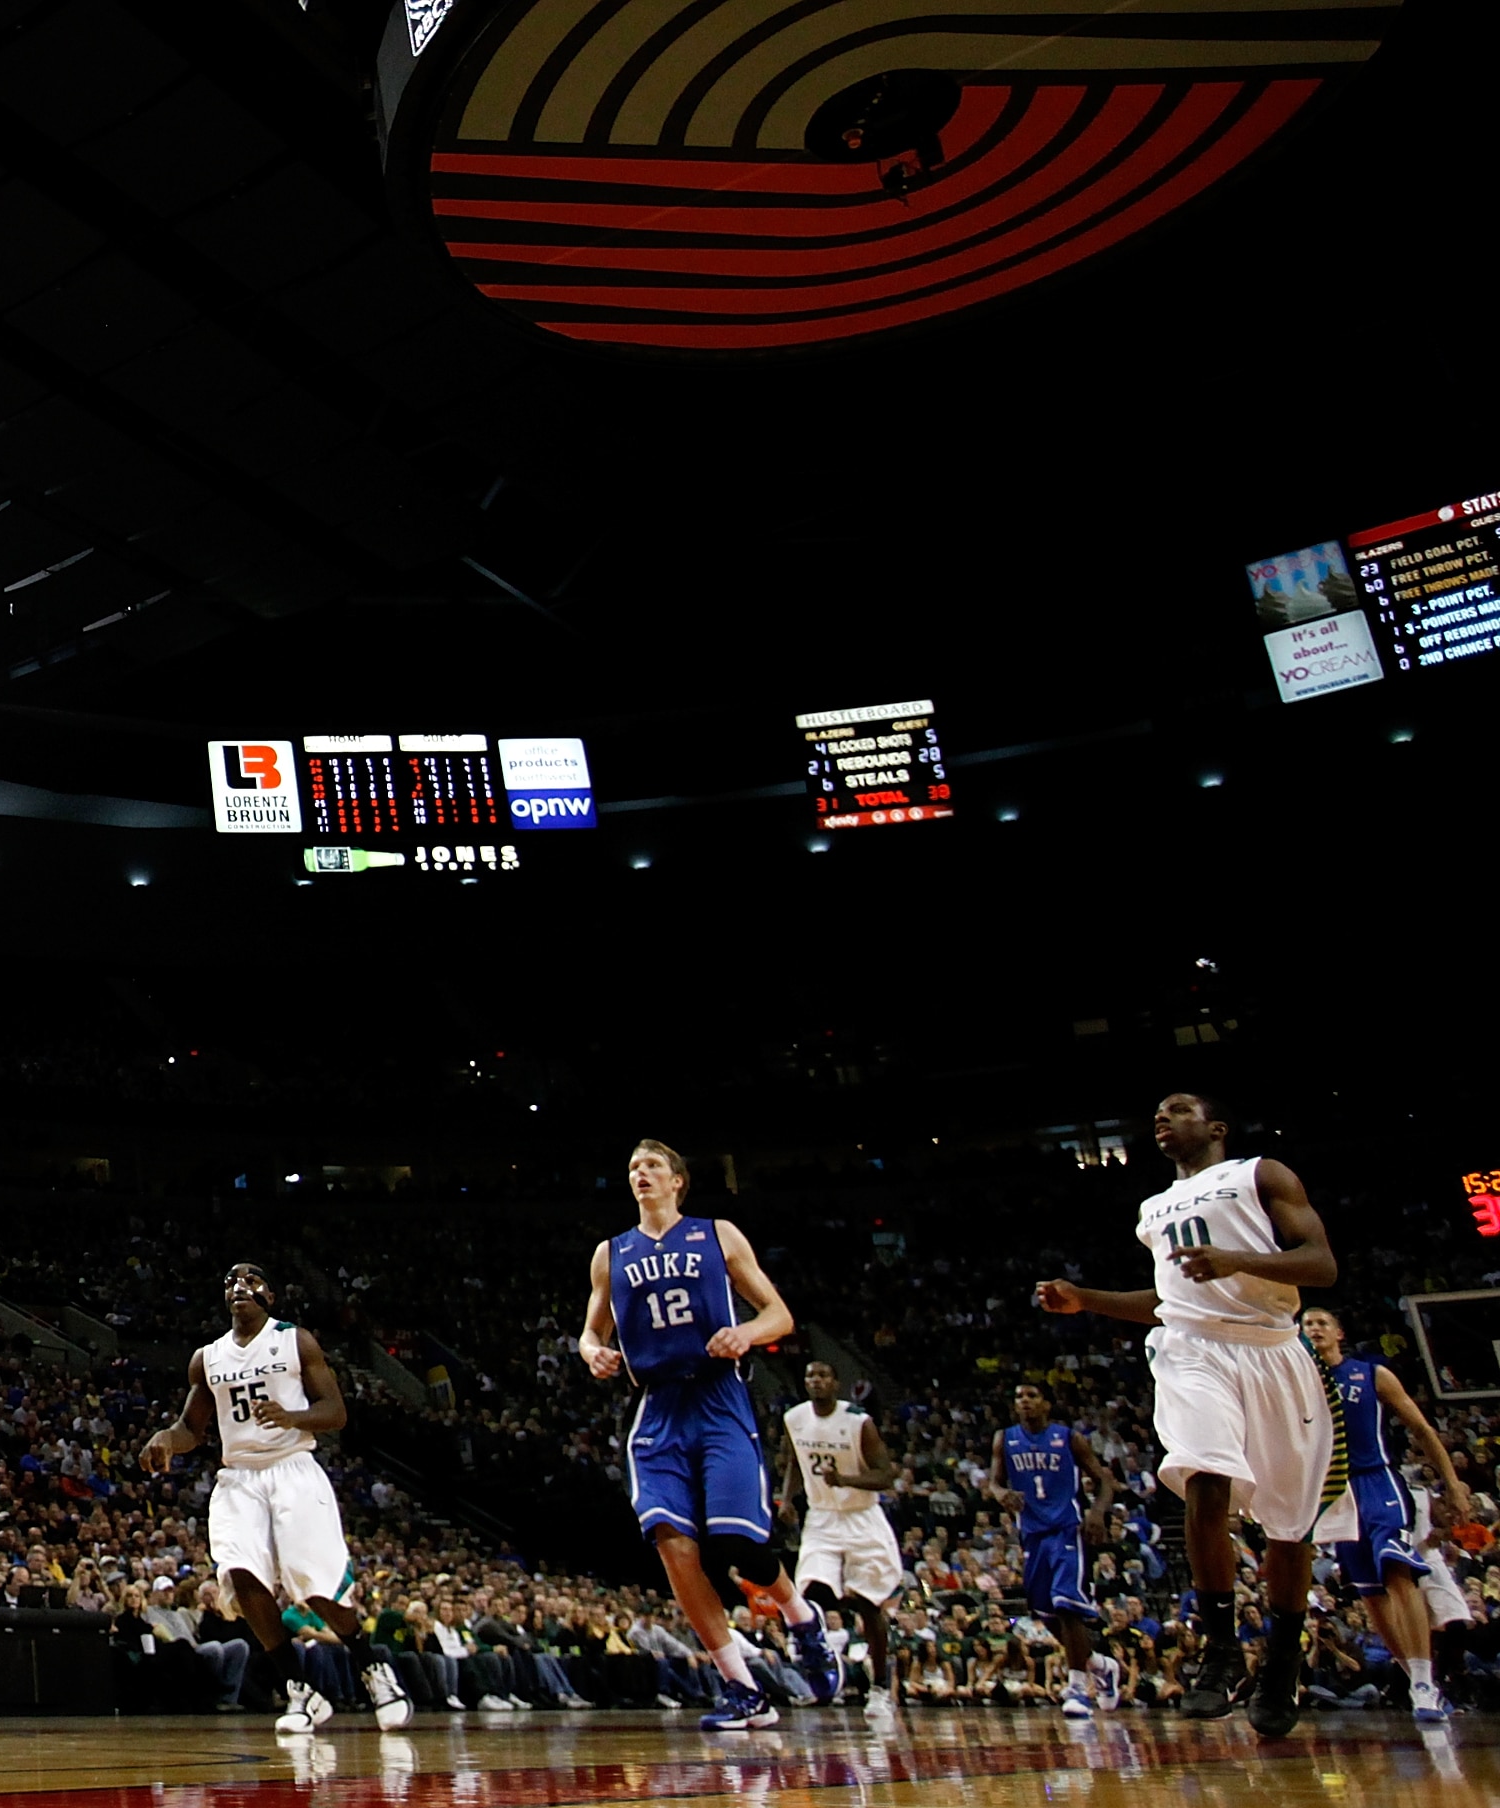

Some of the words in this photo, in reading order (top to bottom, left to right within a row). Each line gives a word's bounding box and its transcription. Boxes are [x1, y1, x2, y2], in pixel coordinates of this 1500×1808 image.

[1360, 562, 1379, 578] 23
[1390, 552, 1423, 570] FIELD
[1425, 544, 1455, 560] GOAL
[1456, 535, 1484, 551] PCT.
[1365, 578, 1384, 593] 60
[1391, 570, 1420, 587] FREE
[1422, 558, 1464, 578] THROW
[1465, 550, 1494, 566] PCT.
[1394, 586, 1422, 602] FREE
[1423, 575, 1469, 594] THROWS
[1469, 565, 1499, 581] MADE
[1466, 585, 1495, 600] PCT.
[1292, 629, 1316, 642] It's
[1320, 620, 1339, 635] all
[1393, 626, 1400, 636] 1
[1419, 633, 1442, 649] OFF
[1399, 657, 1410, 670] 0
[1418, 651, 1443, 666] 2ND
[1444, 637, 1493, 660] CHANCE
[1280, 650, 1376, 683] YOCREAM
[804, 702, 923, 726] HUSTLEBOARD
[805, 727, 855, 741] BLAZERS
[815, 743, 826, 755] 4
[828, 737, 876, 755] BLOCKED
[876, 733, 912, 749] SHOTS
[925, 728, 937, 744] 5
[524, 746, 558, 755] office
[808, 760, 831, 776] 21
[837, 751, 912, 771] REBOUNDS
[918, 746, 941, 763] 28
[509, 758, 578, 770] products
[514, 773, 577, 782] northwest
[822, 778, 834, 792] 6
[845, 769, 910, 788] STEALS
[933, 764, 945, 779] 5
[225, 796, 288, 808] LORENTZ
[510, 797, 591, 825] opnw
[816, 797, 838, 812] 31
[854, 790, 910, 807] TOTAL
[227, 809, 290, 823] BRUUN
[415, 846, 517, 862] JONES
[1161, 1215, 1211, 1265] 10
[624, 1252, 702, 1288] DUKE
[646, 1288, 694, 1329] 12
[210, 1362, 287, 1385] DUCKS
[229, 1381, 269, 1422] 55
[809, 1452, 837, 1475] 23
[1011, 1452, 1061, 1472] DUKE
[1033, 1475, 1046, 1499] 1
